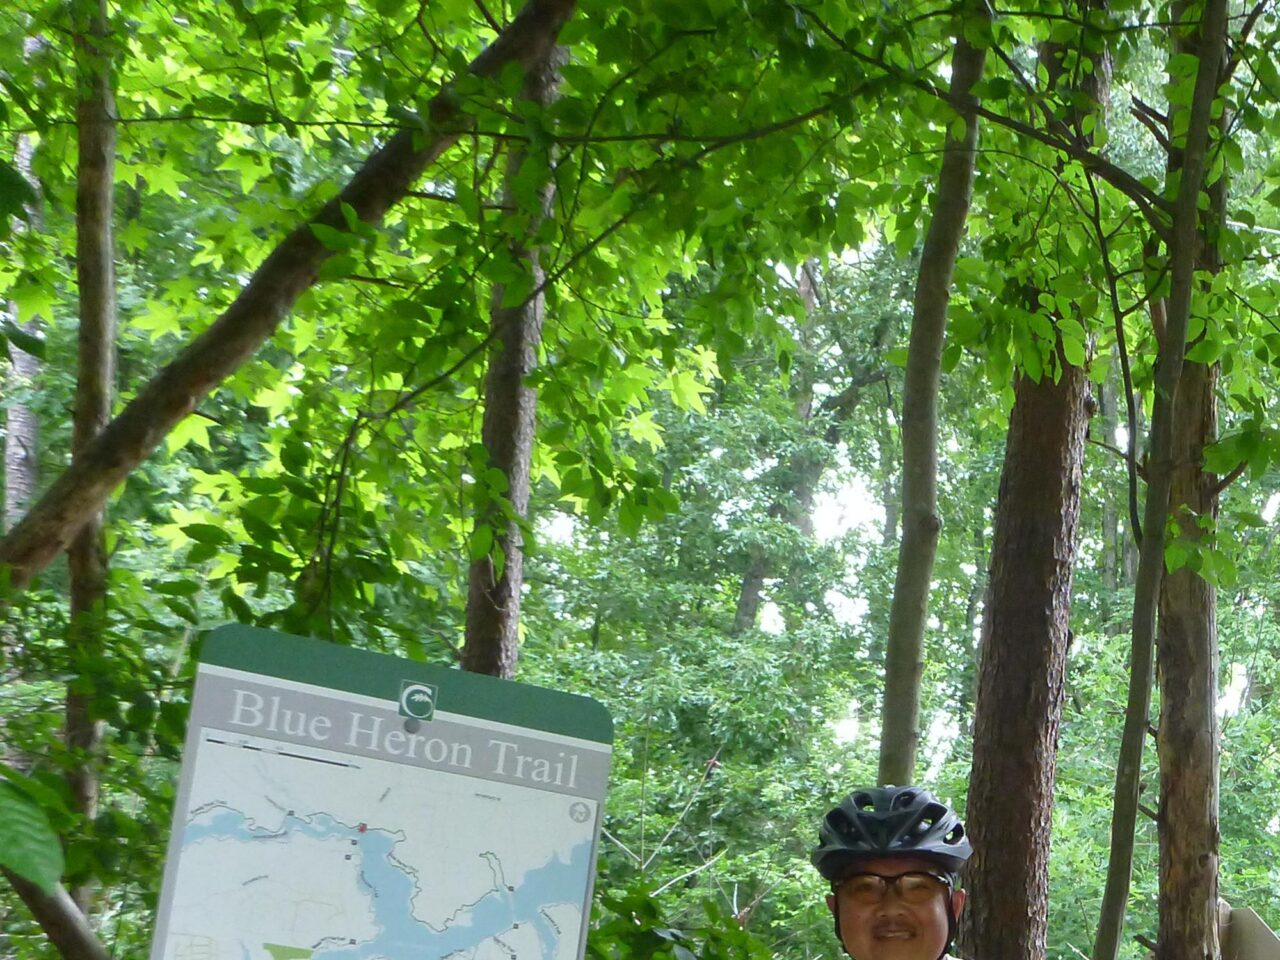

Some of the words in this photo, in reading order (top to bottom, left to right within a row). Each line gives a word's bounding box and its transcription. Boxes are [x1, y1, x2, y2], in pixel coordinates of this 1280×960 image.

[230, 689, 333, 741] Blue
[344, 711, 473, 769] Heron
[487, 740, 579, 789] Trail
